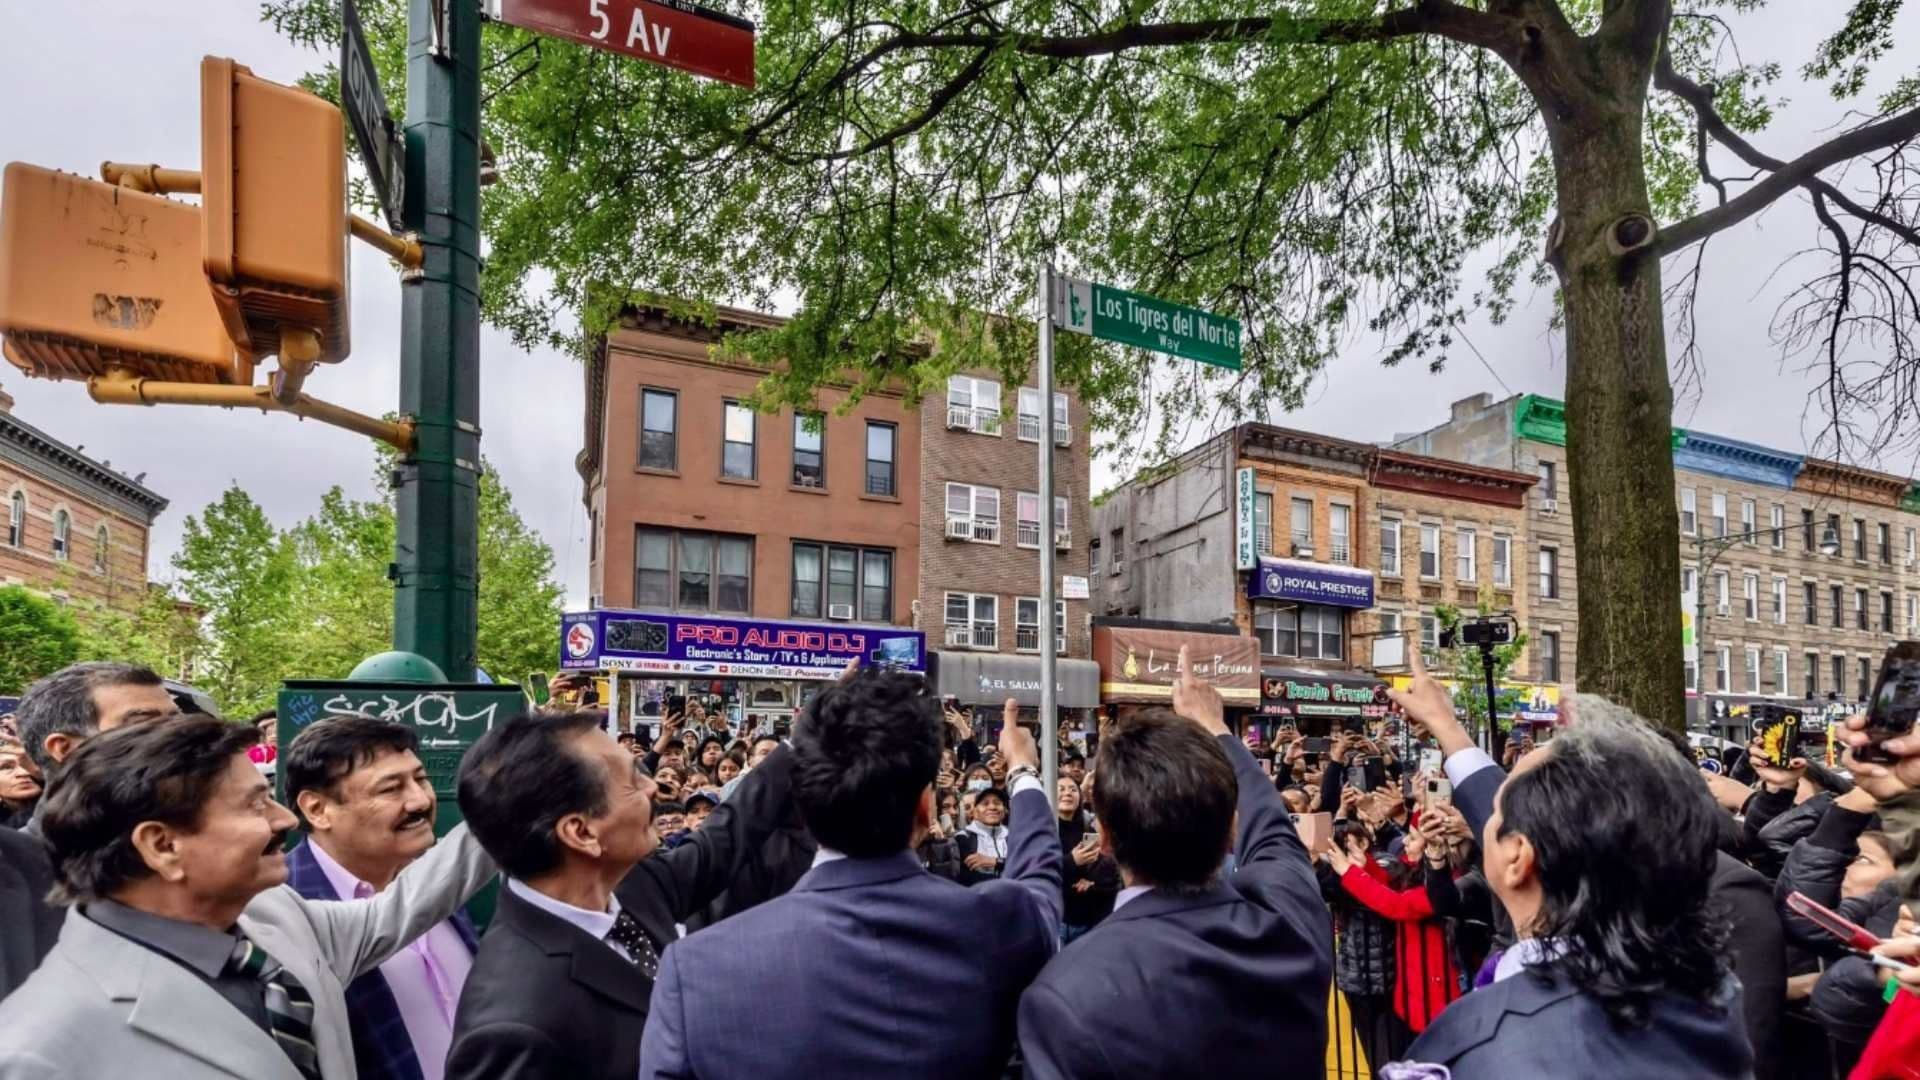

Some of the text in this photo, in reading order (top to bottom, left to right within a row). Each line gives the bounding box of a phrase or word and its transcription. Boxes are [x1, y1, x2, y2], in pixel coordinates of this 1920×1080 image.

[589, 0, 671, 56] 5 Av
[1096, 289, 1236, 349] Los Tigres del Norte
[1158, 333, 1181, 353] Way
[1284, 577, 1319, 591] ROYAL
[1320, 581, 1369, 597] PRESTIGE
[676, 623, 866, 653] PRO AUDIO DJ
[601, 659, 633, 668] SONY
[731, 665, 763, 674] DENON
[686, 645, 742, 660] Electronic's
[743, 649, 770, 662] Store
[809, 652, 850, 667] Applianc
[1148, 649, 1170, 674] La
[1213, 653, 1254, 676] Peruana
[993, 679, 1007, 689] EL
